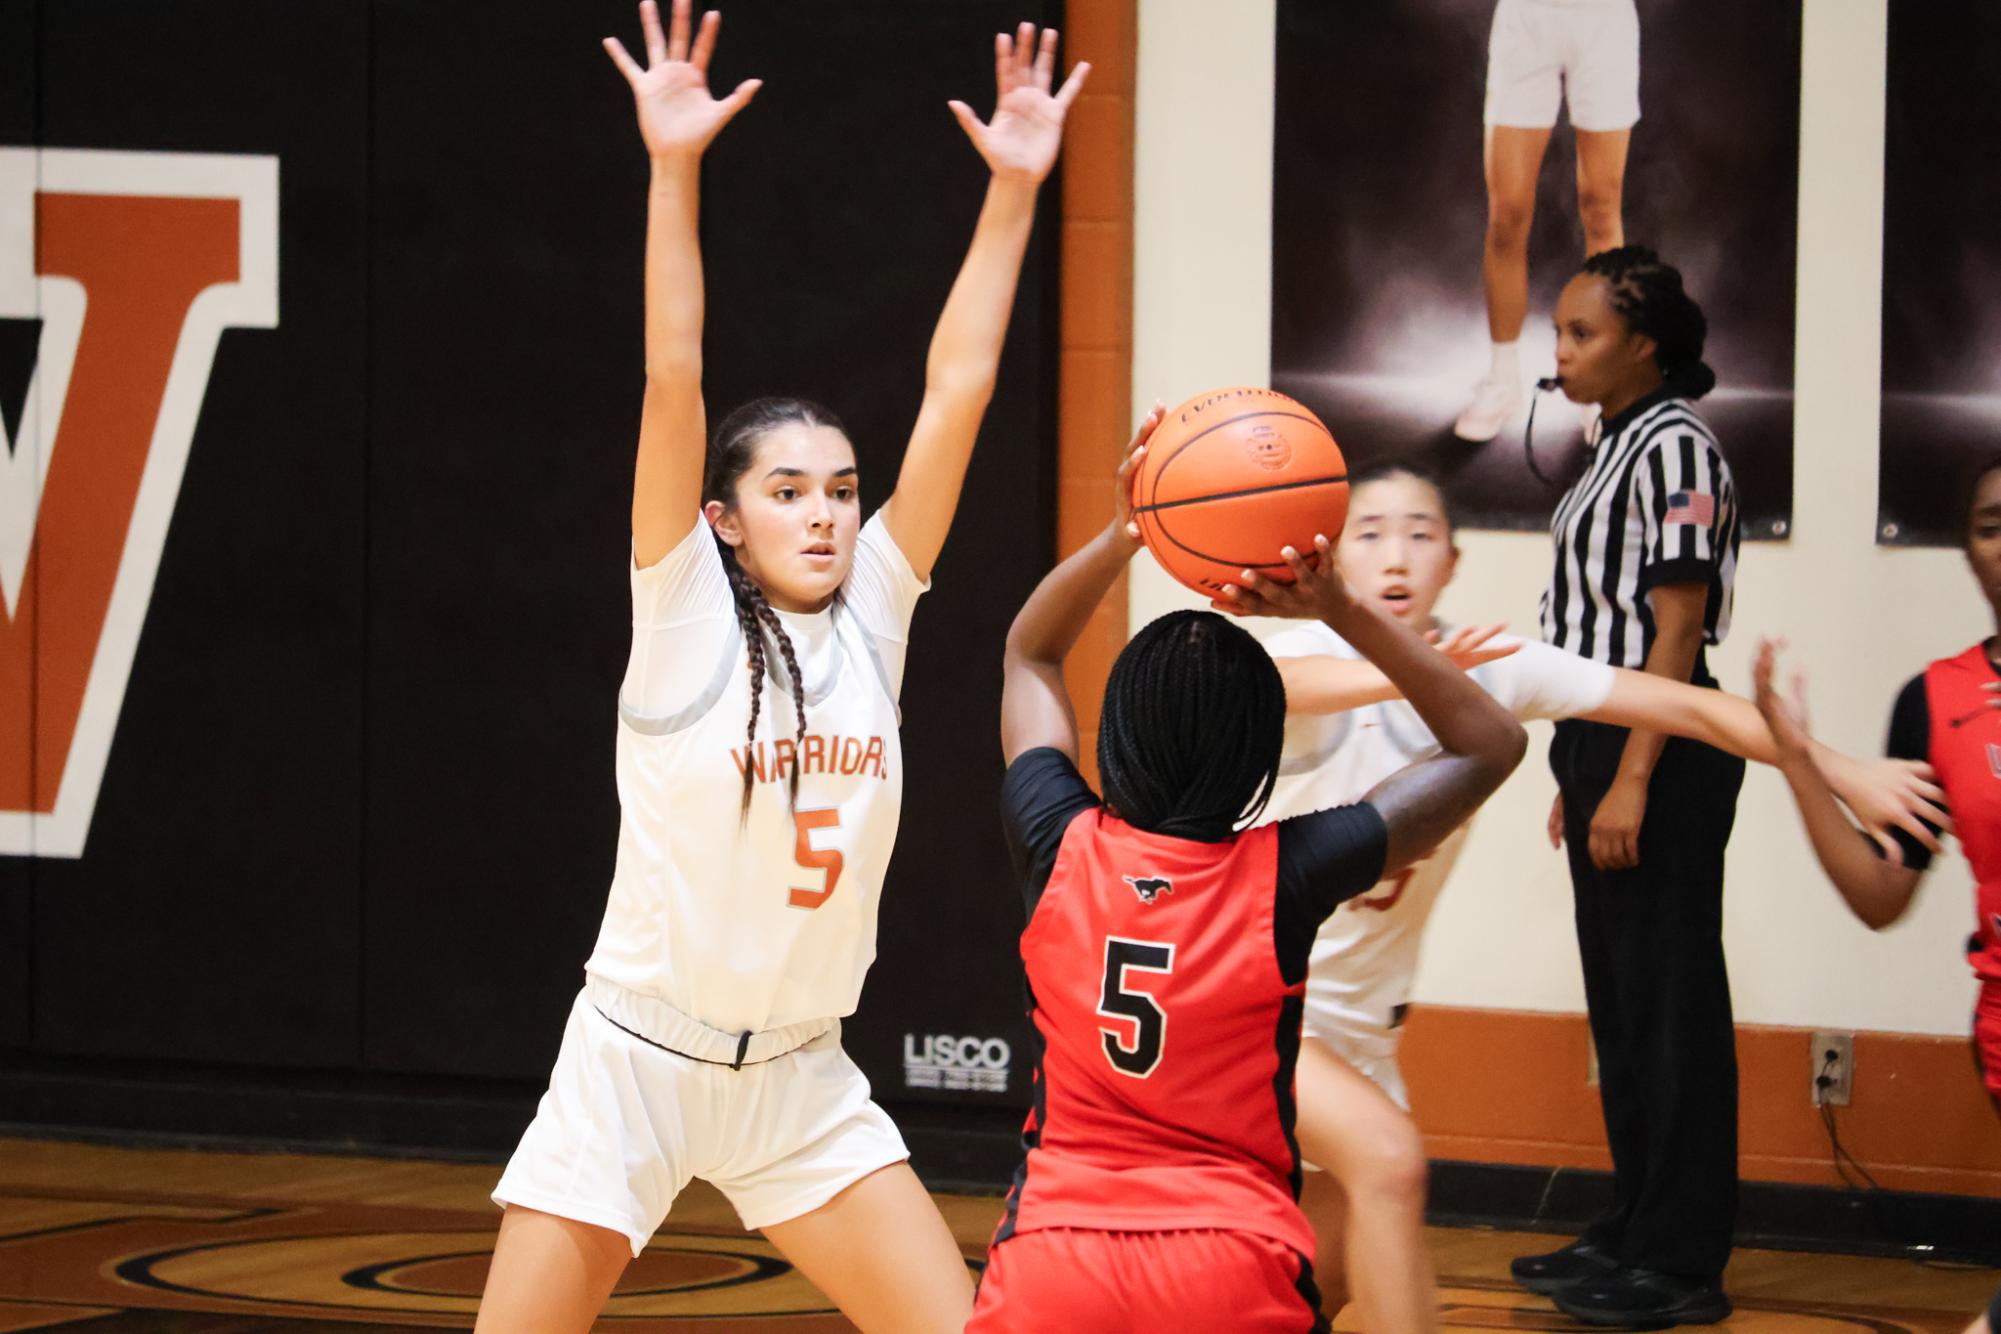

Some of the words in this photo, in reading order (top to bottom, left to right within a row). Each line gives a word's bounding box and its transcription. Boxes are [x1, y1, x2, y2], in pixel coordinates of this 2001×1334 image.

[786, 806, 845, 910] 5
[904, 1033, 1010, 1069] LISCO
[1096, 934, 1176, 1079] 5
